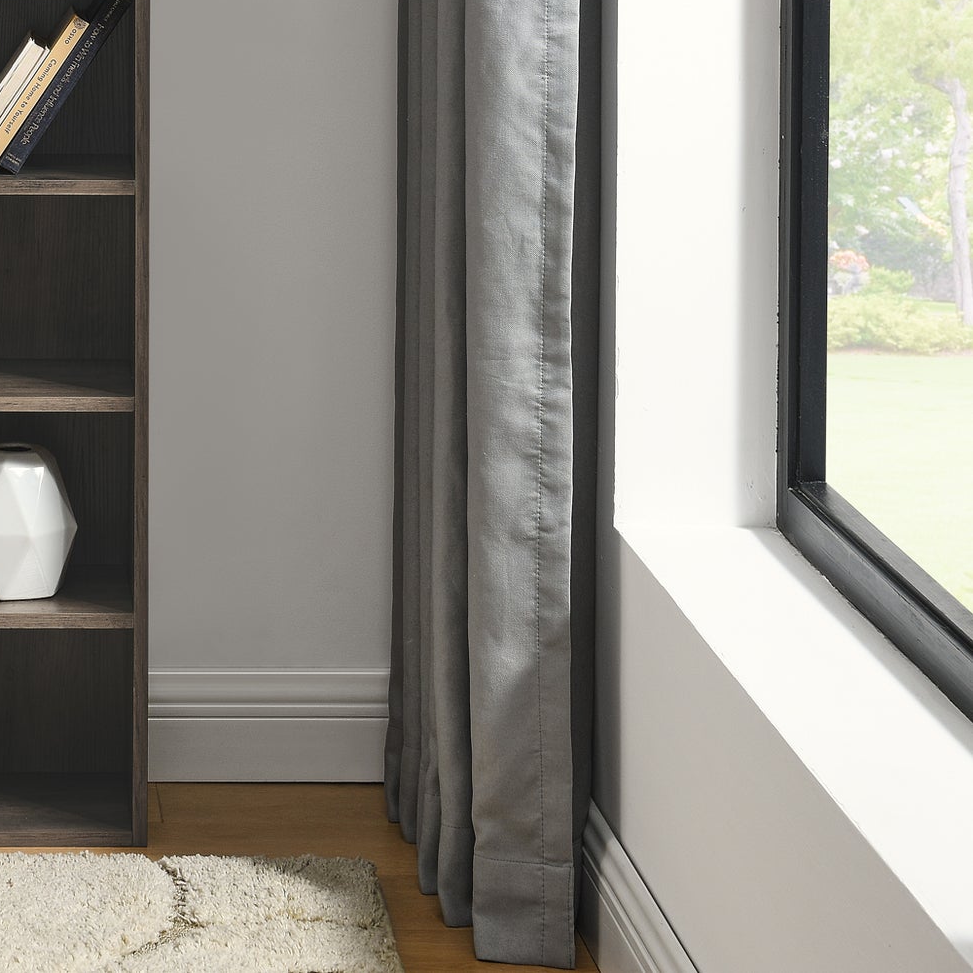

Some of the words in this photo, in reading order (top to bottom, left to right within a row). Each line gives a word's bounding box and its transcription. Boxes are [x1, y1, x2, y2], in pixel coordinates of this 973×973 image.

[64, 28, 76, 44] OSHO
[37, 58, 56, 82] Coming
[25, 82, 41, 101] Home
[3, 109, 23, 134] Yourself
